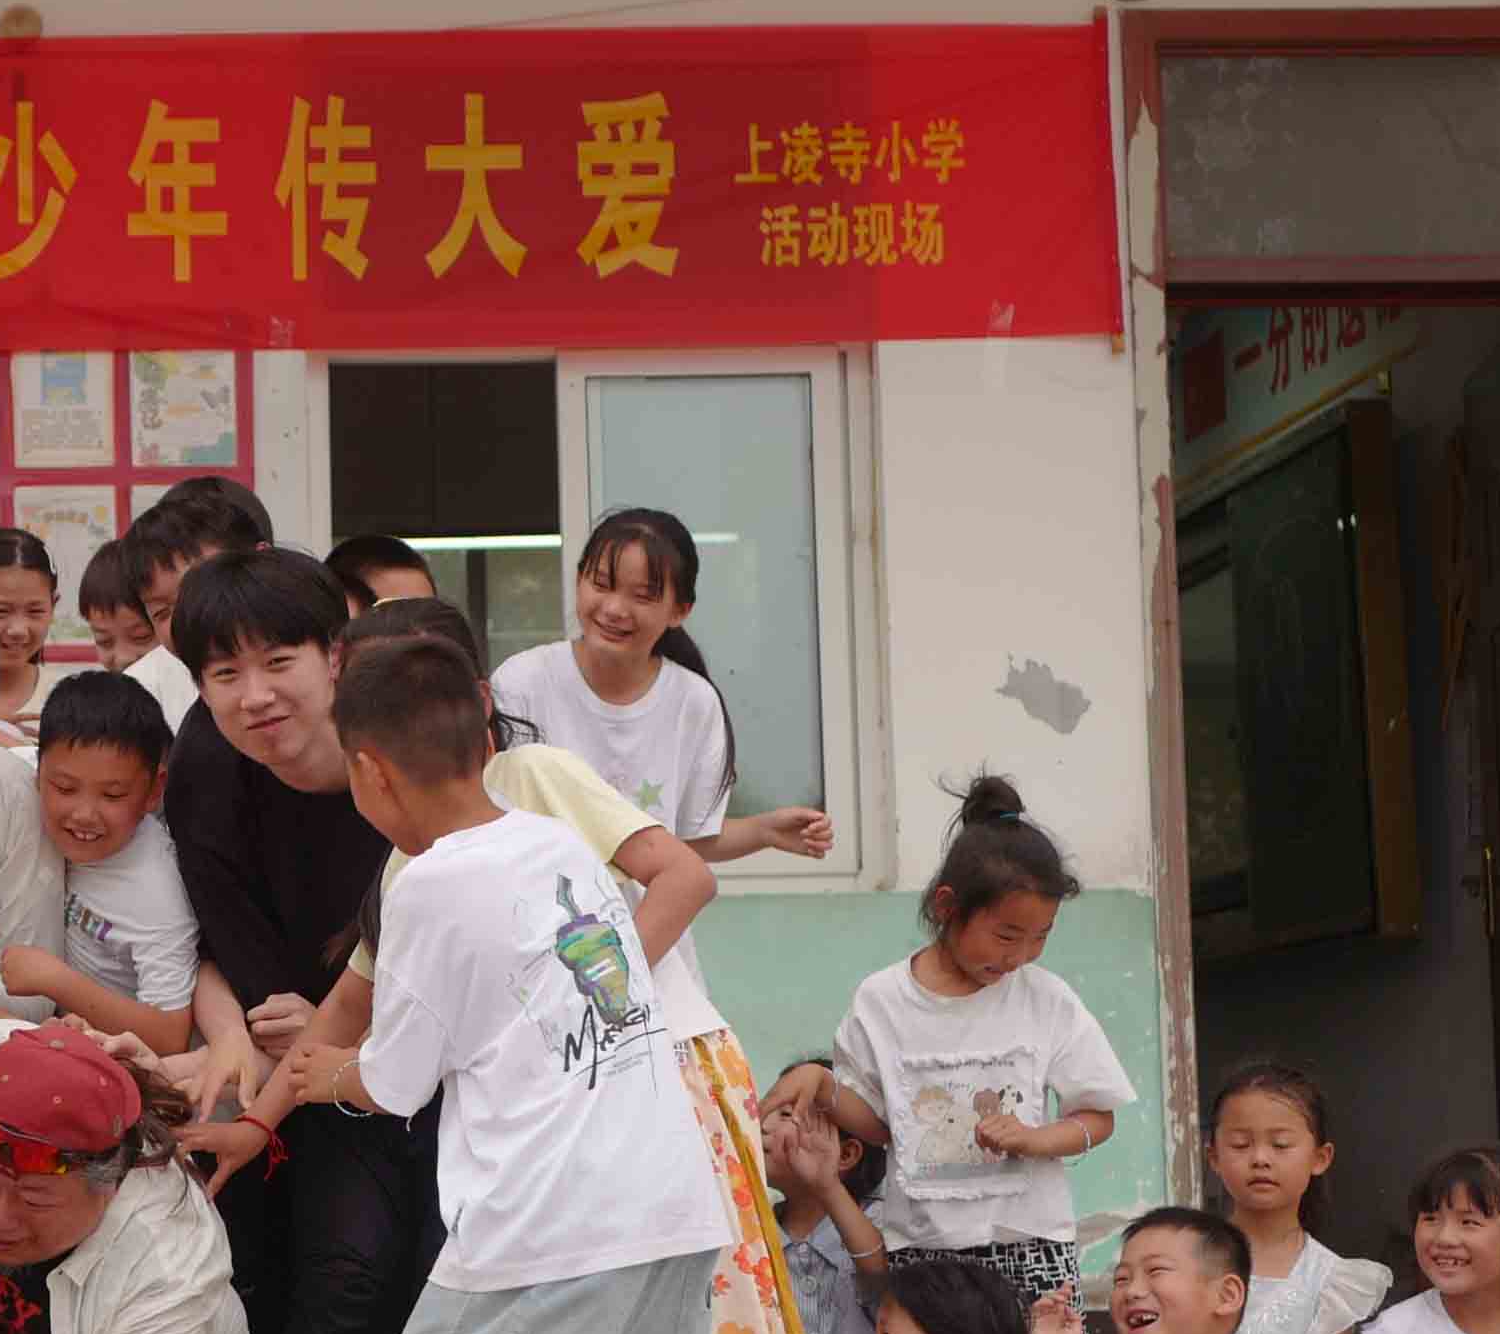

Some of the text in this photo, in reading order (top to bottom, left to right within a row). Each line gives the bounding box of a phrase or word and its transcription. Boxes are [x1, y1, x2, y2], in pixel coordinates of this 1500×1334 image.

[733, 118, 967, 185] 上凌寺小学
[758, 200, 946, 267] 活动现场
